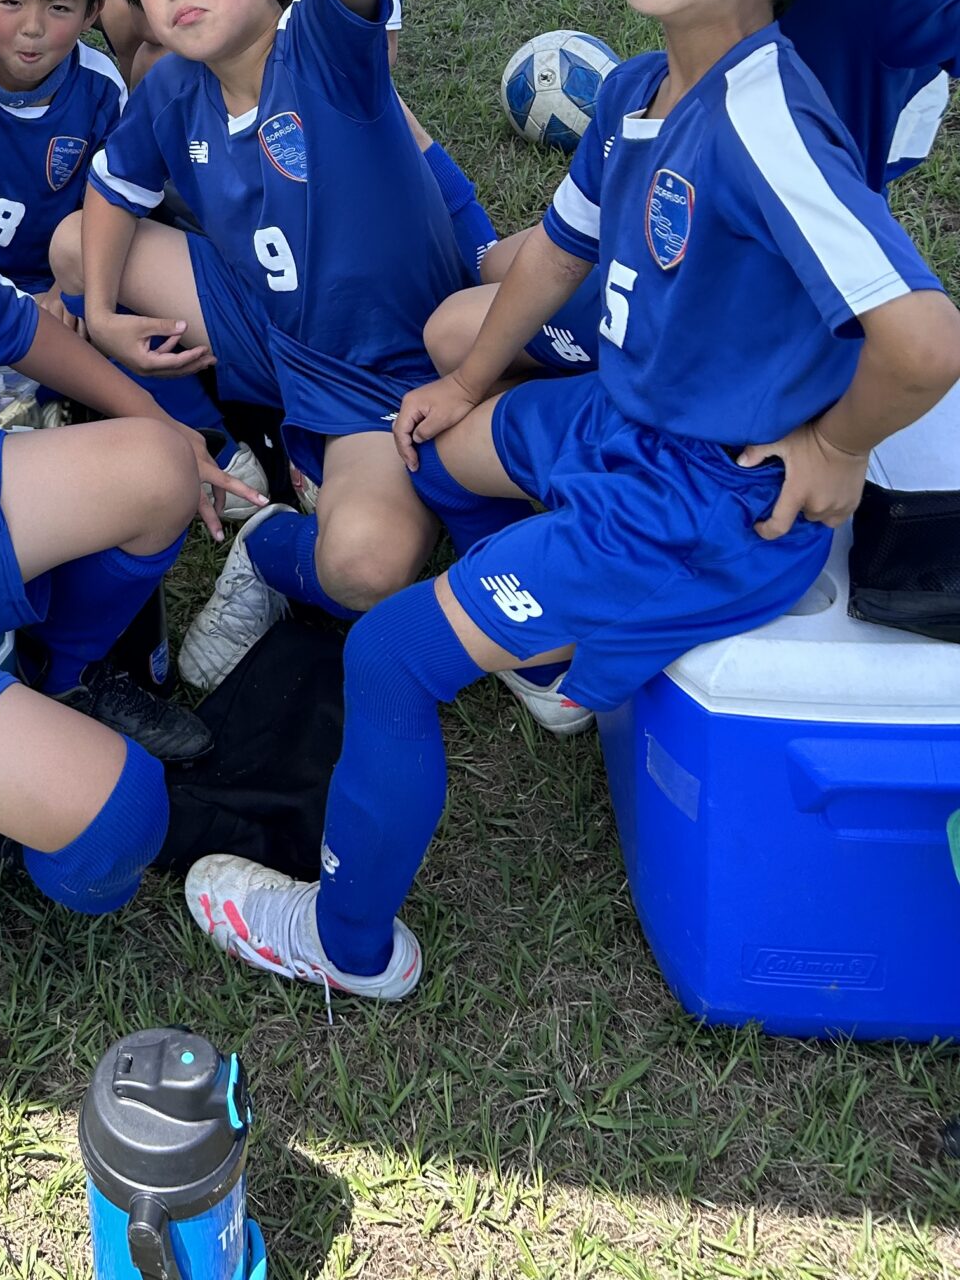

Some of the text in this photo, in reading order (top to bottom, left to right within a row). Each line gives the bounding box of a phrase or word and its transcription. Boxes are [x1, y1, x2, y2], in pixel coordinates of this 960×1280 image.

[264, 122, 297, 144] SORRISO
[653, 183, 687, 206] SORRISO
[253, 226, 299, 292] 9
[598, 258, 639, 350] 5
[217, 1203, 245, 1252] THE
